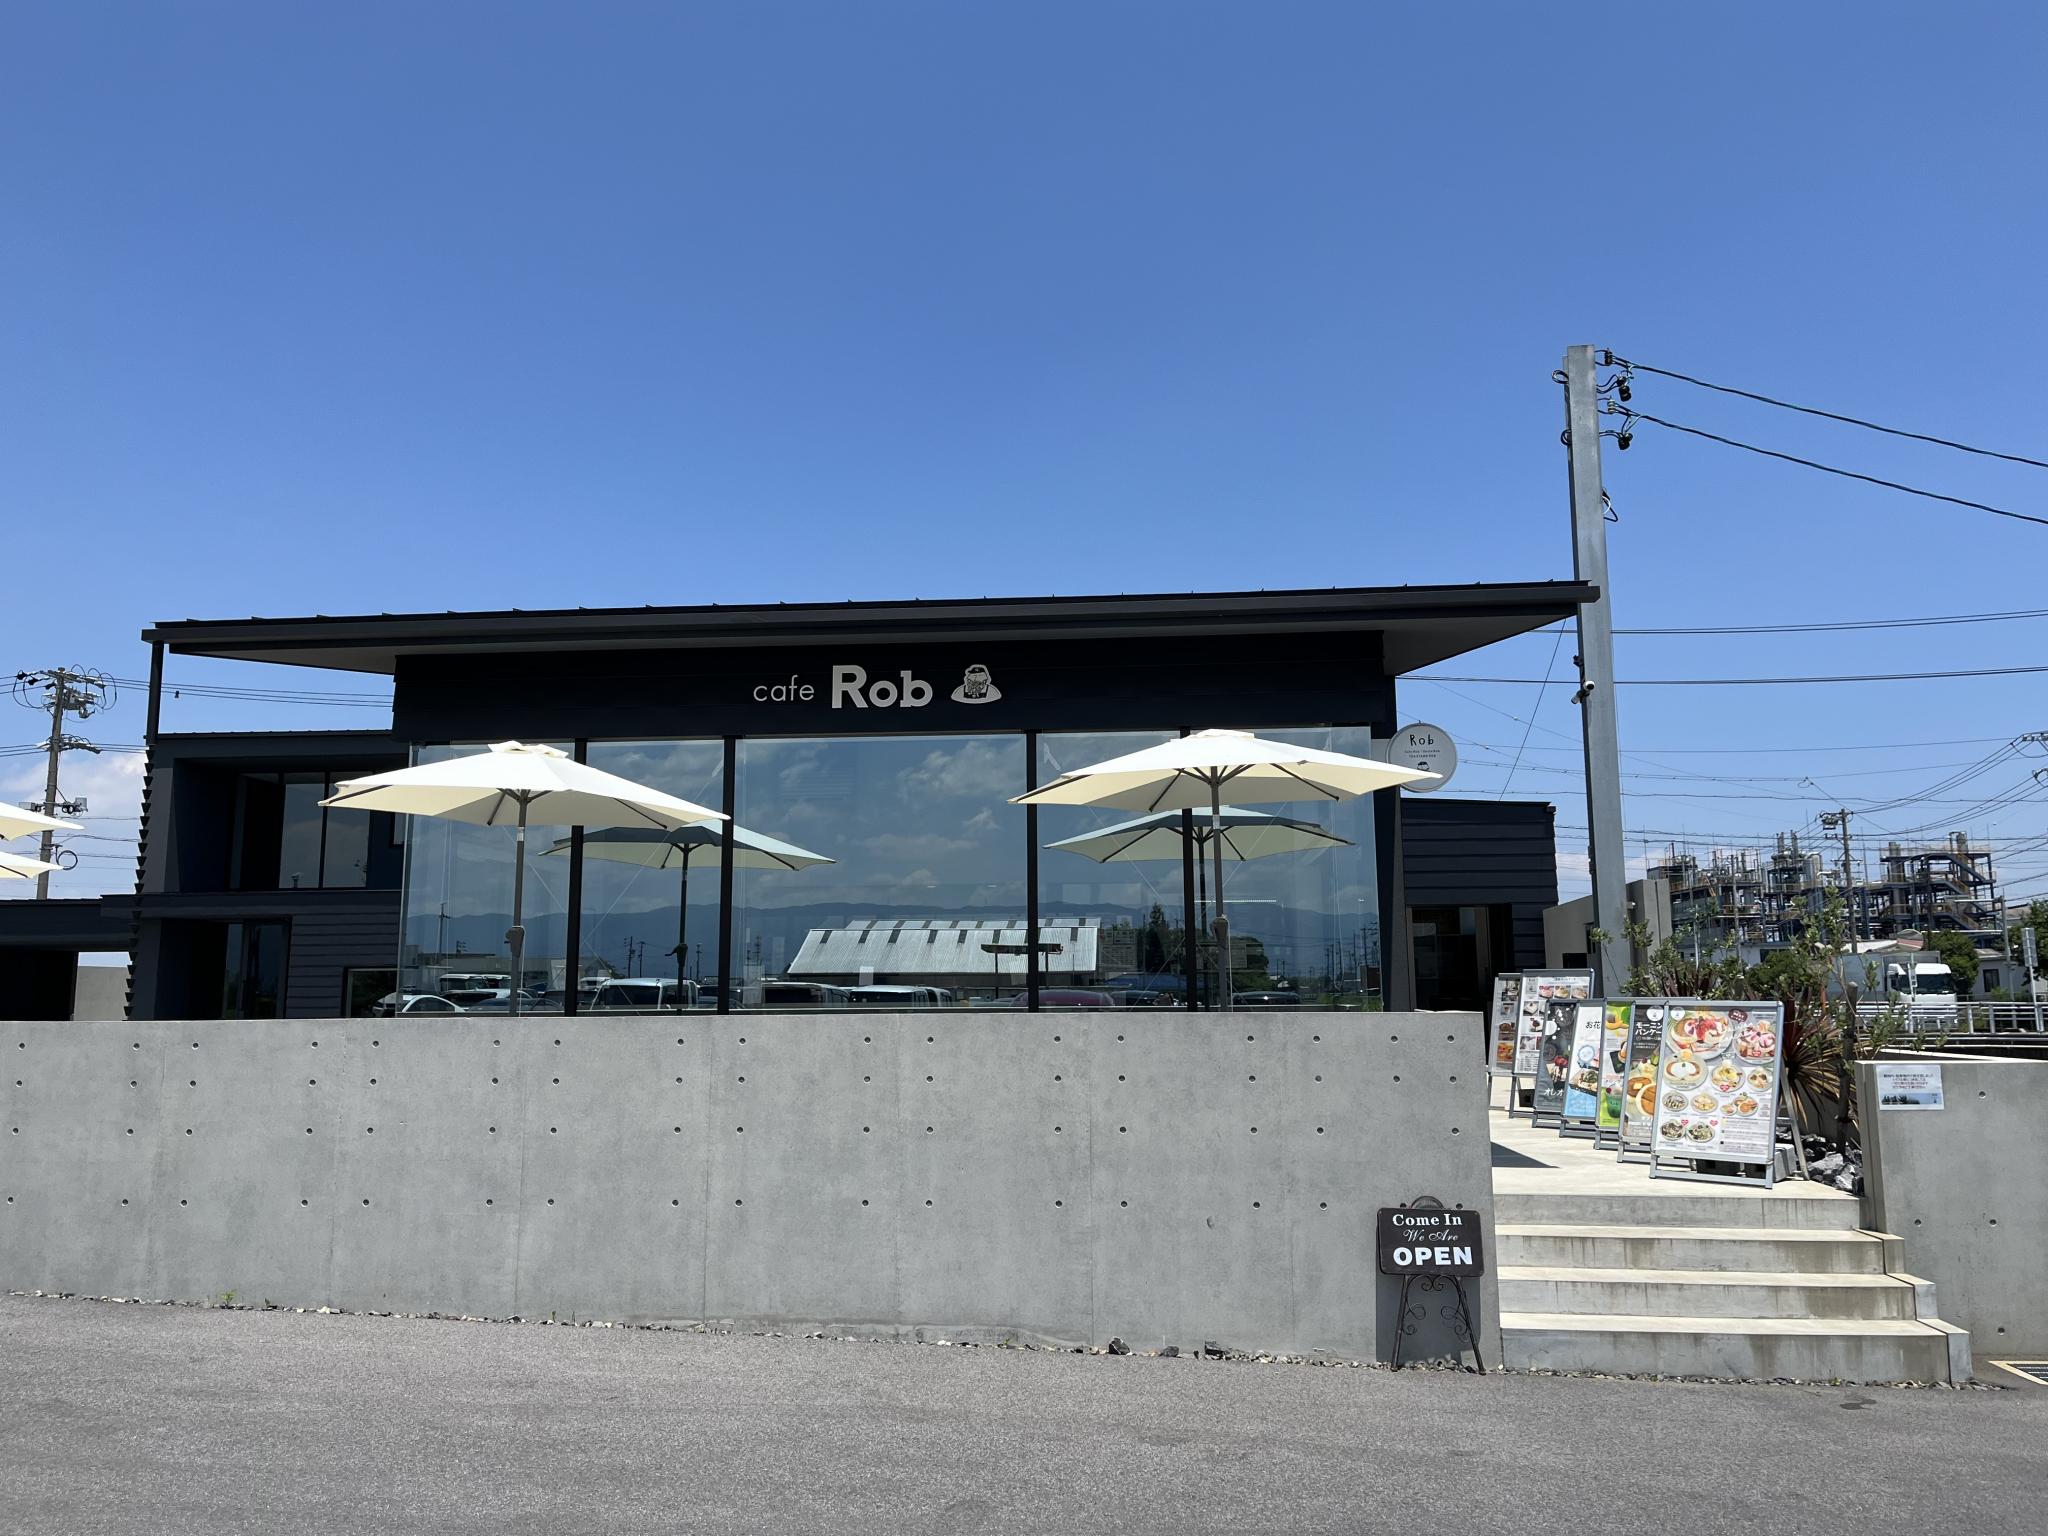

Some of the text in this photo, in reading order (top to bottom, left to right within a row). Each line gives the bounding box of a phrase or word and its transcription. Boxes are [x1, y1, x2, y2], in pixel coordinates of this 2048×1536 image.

[753, 664, 933, 709] cafe Rob
[1409, 734, 1434, 746] Rob
[1392, 1213, 1463, 1227] Come In
[1403, 1229, 1459, 1242] We Are
[1392, 1246, 1473, 1267] OPEN
